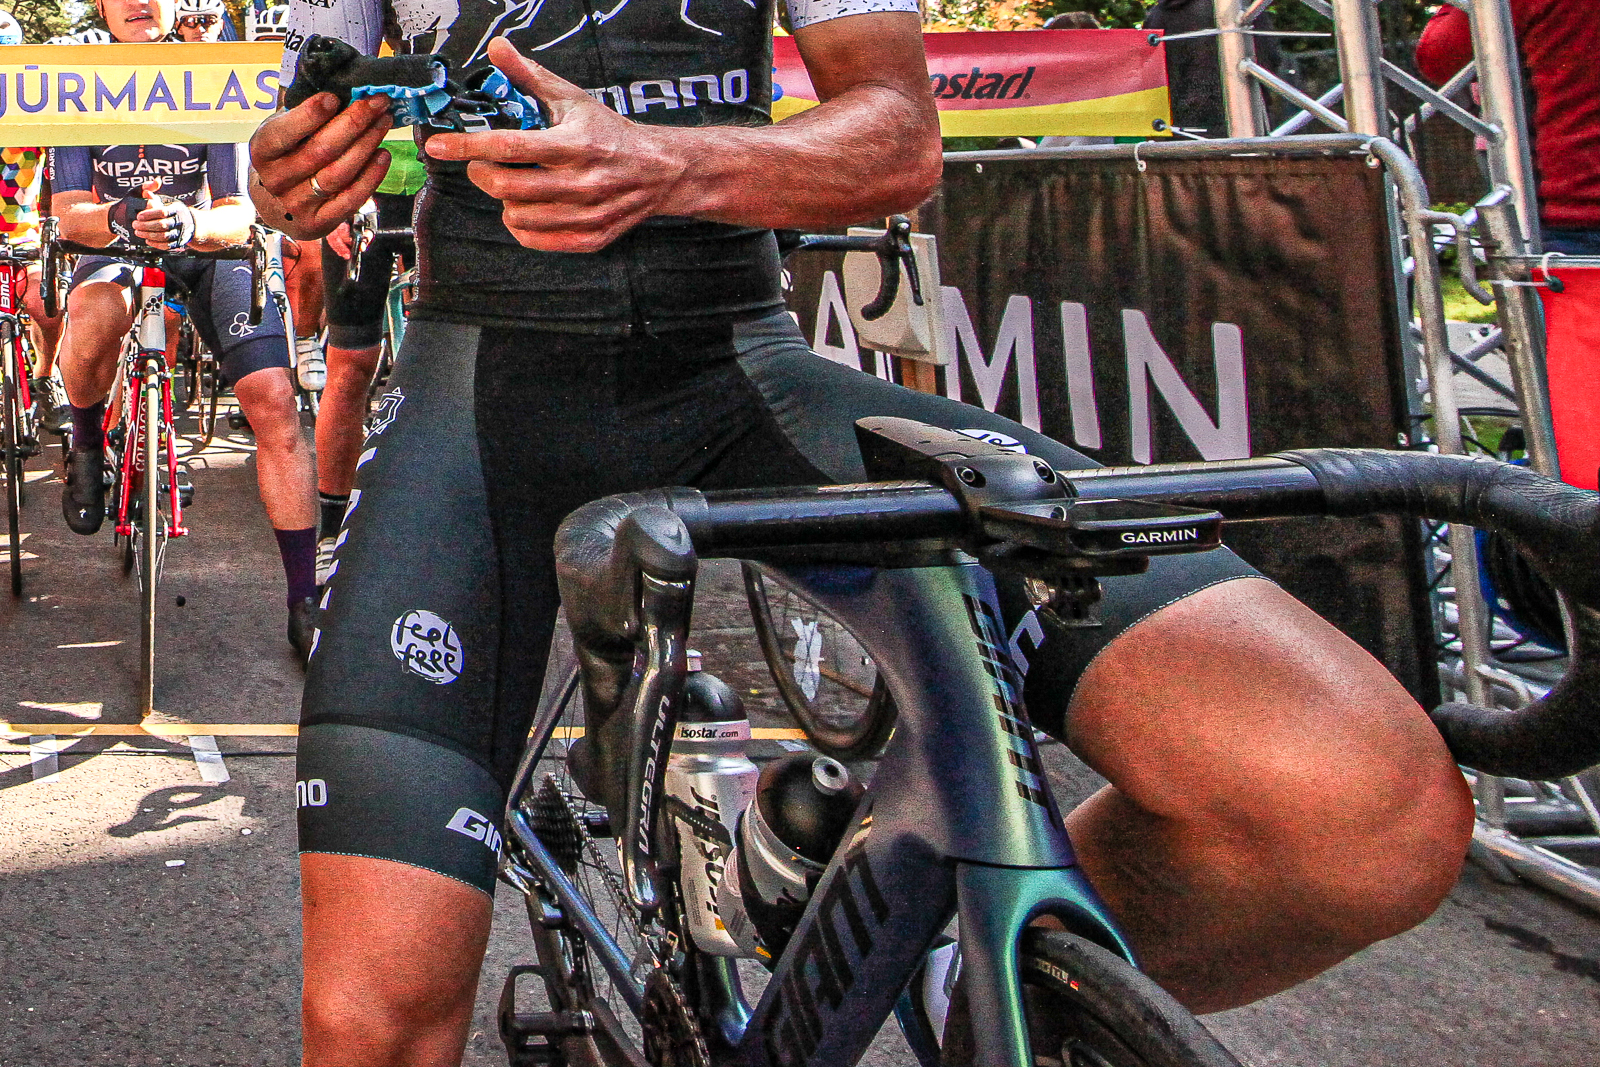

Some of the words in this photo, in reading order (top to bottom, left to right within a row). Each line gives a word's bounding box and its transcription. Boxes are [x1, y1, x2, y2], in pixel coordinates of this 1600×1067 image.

[93, 157, 200, 177] KIPARIS
[0, 272, 10, 309] BMC
[1120, 528, 1197, 545] GARMIN
[637, 694, 670, 857] ULTEGRA
